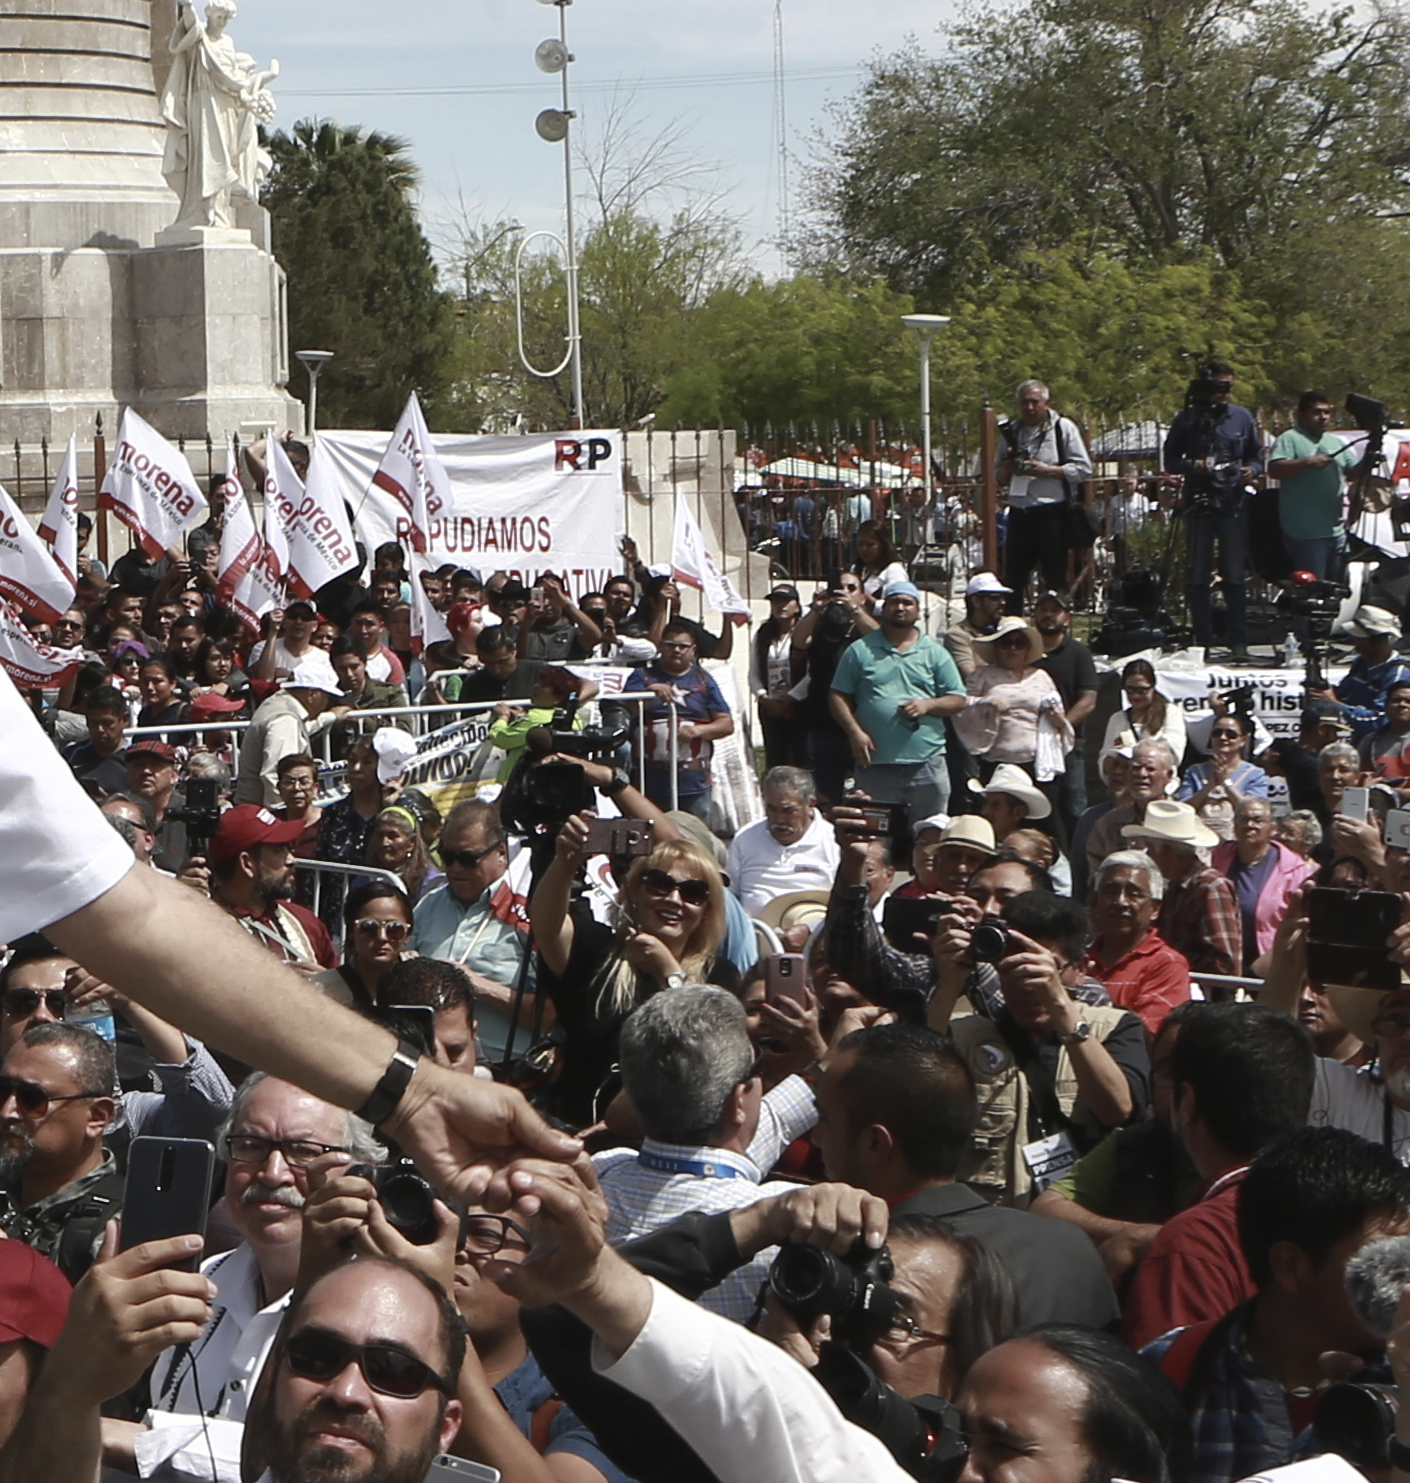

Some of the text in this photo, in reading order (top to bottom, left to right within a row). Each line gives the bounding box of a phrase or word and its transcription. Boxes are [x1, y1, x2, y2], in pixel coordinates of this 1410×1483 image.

[119, 440, 196, 517] morena
[299, 496, 352, 566] orena
[396, 515, 552, 554] RPUDIAMOS
